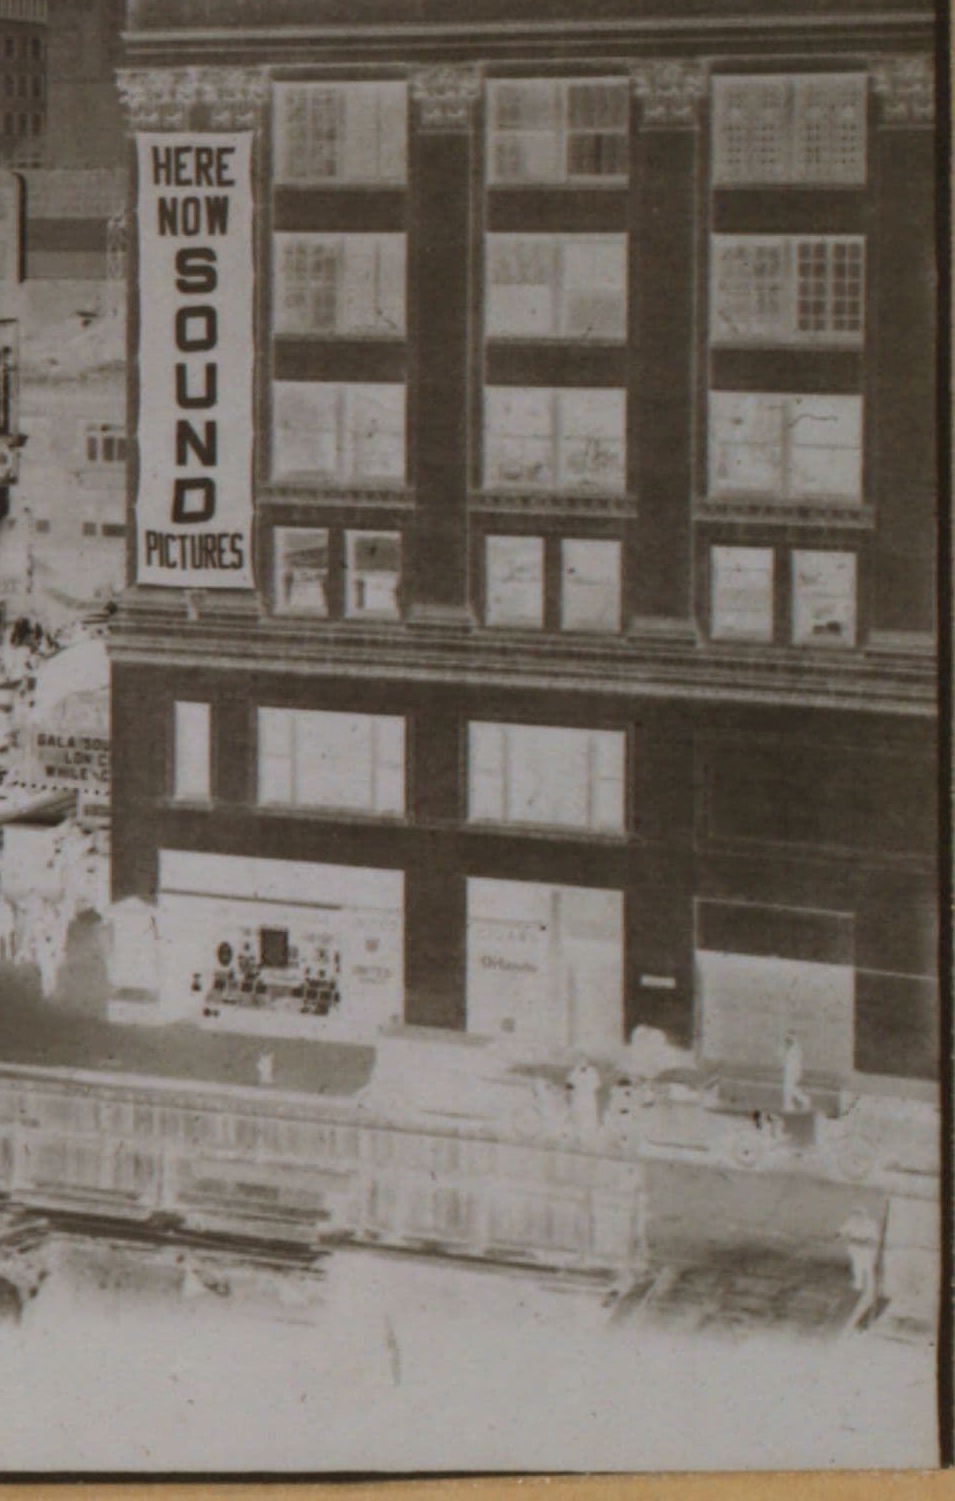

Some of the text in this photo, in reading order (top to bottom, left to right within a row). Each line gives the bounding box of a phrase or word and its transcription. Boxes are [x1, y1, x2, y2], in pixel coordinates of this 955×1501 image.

[151, 145, 235, 187] HERE
[157, 196, 229, 236] NOW
[171, 247, 218, 524] SOUND
[145, 530, 244, 570] PICTURES
[37, 733, 76, 749] GALA
